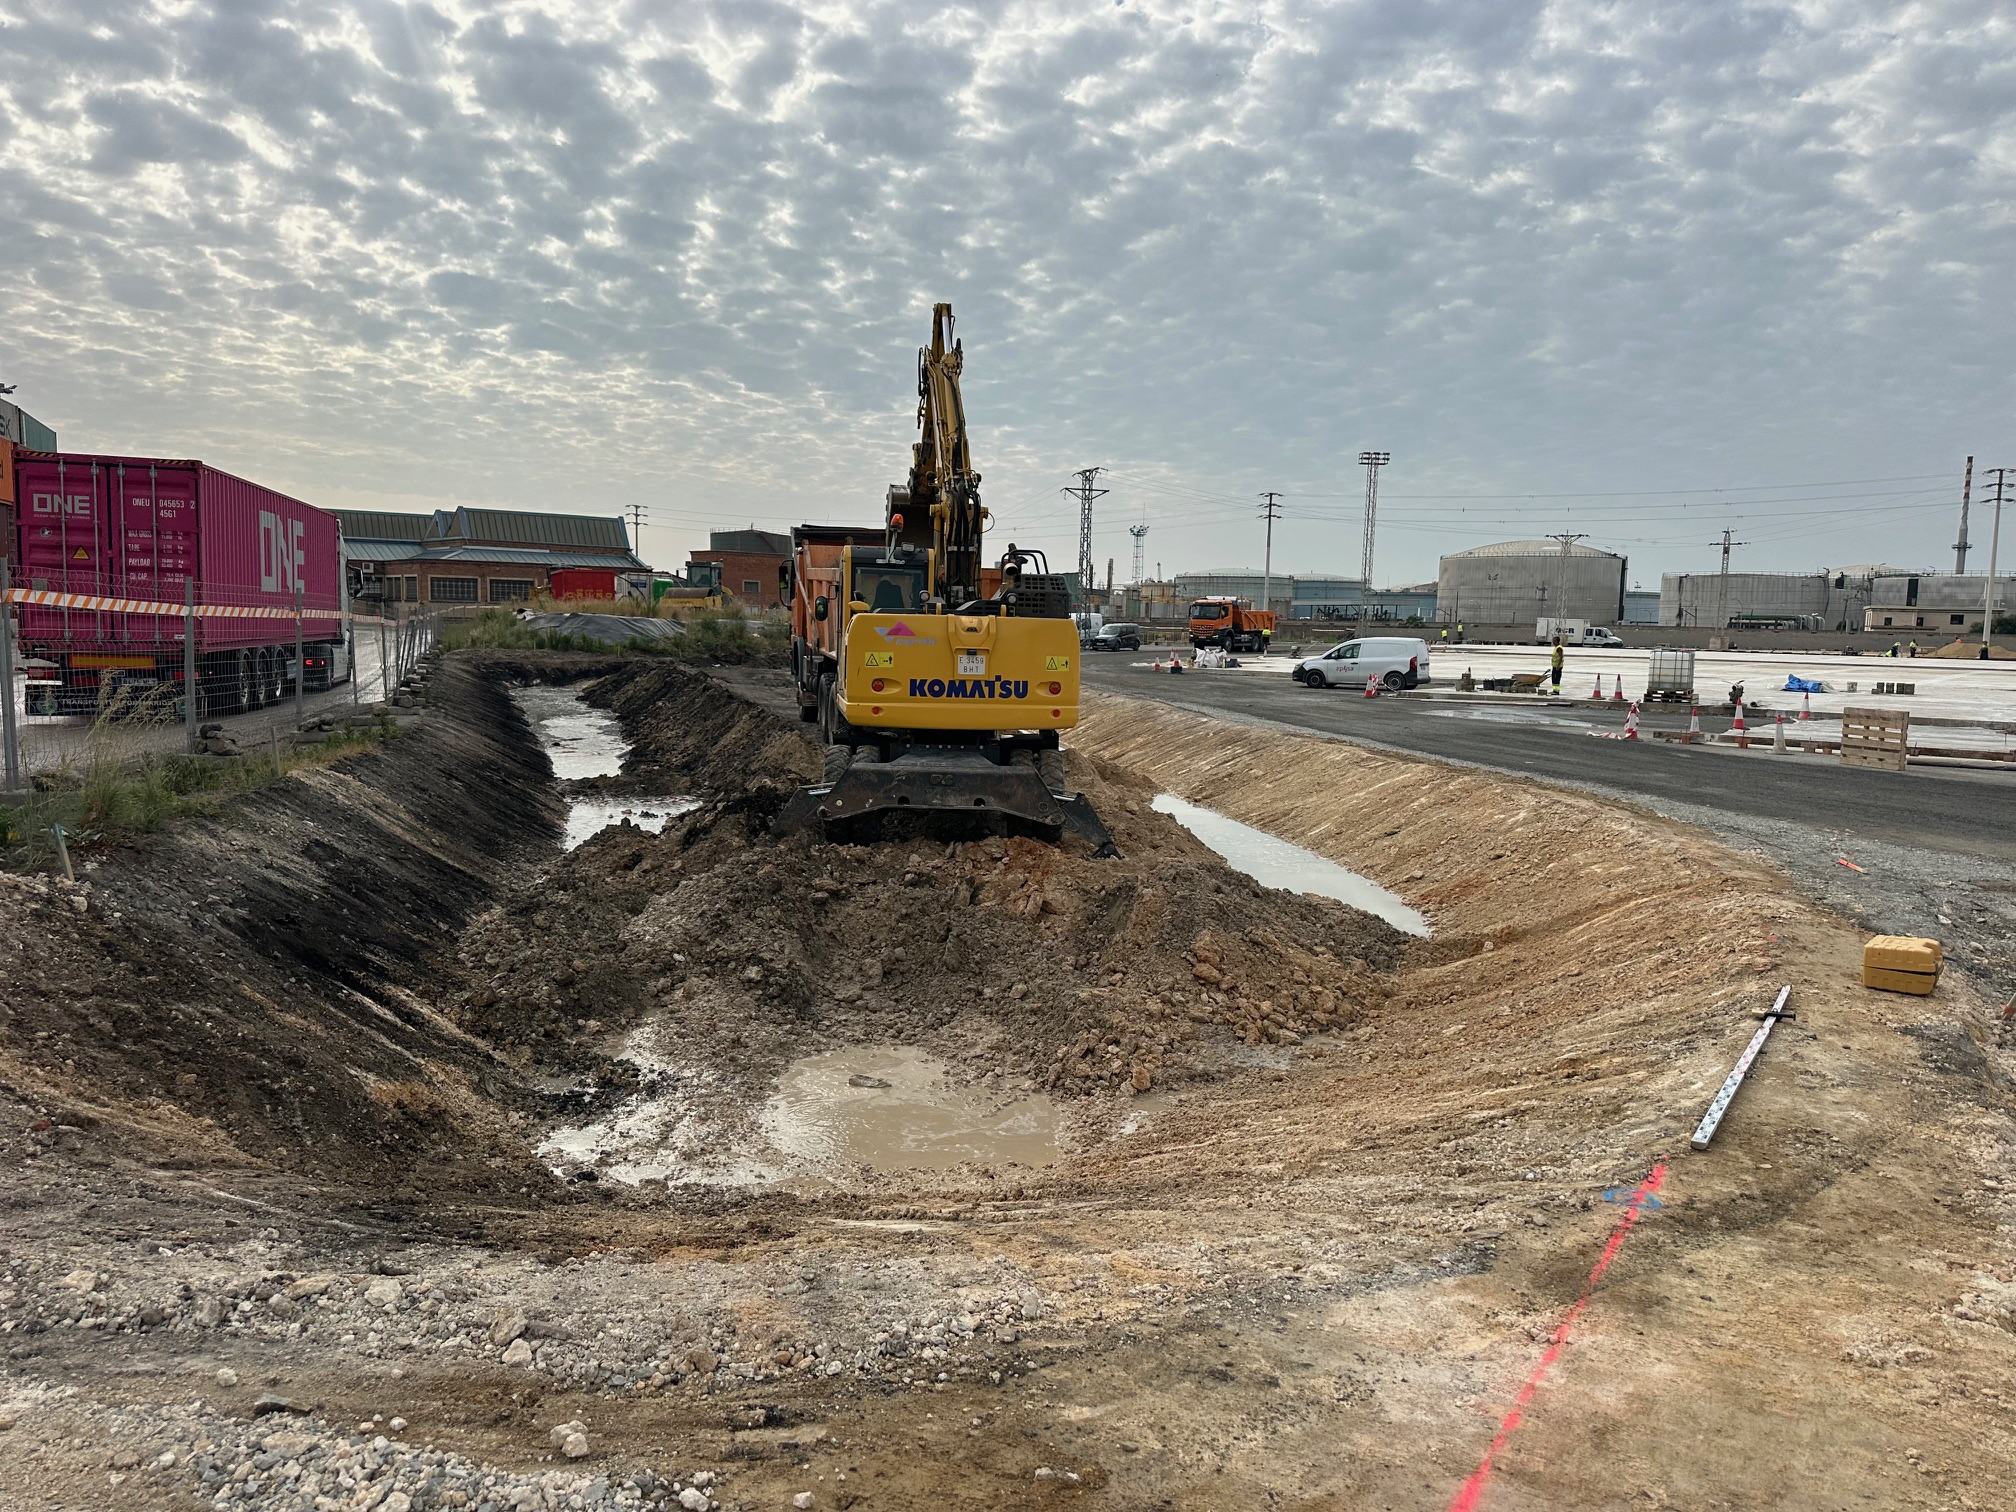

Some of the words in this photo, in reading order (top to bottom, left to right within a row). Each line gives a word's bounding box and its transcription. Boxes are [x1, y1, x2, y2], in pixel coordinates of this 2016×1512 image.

[33, 494, 90, 514] ONE
[133, 498, 150, 507] ONEU
[190, 500, 196, 509] 2
[160, 510, 176, 518] 45G1
[259, 509, 305, 594] ONE
[129, 558, 150, 566] PAYLOAD
[959, 656, 964, 664] E
[966, 656, 984, 665] 3459
[909, 675, 1029, 699] KOMATSU
